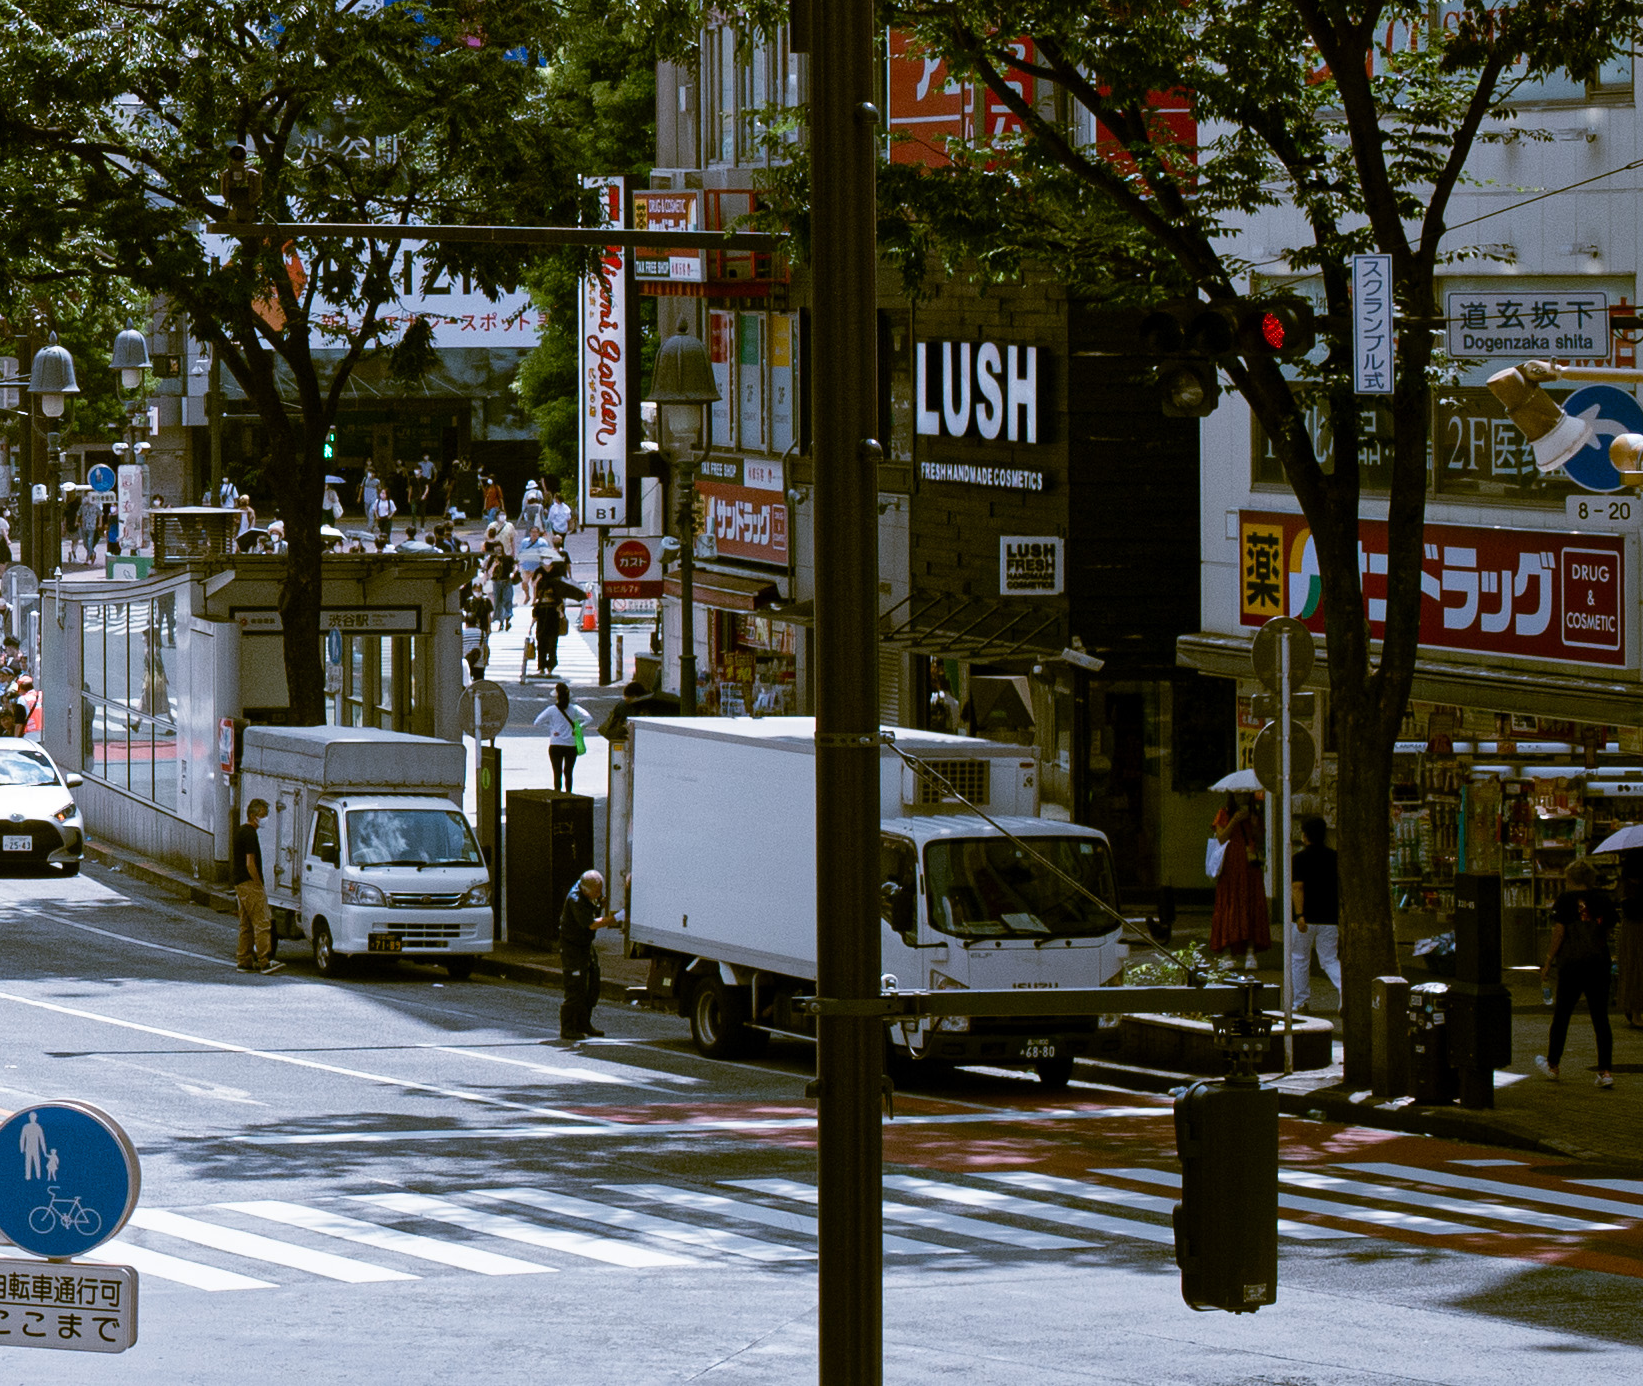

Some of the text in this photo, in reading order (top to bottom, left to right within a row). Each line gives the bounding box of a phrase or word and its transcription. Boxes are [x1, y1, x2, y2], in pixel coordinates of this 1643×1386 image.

[1459, 299, 1597, 331] 道玄坂下
[1362, 260, 1386, 391] スクランブル式
[1463, 333, 1594, 353] Dogenzaka shita
[916, 341, 1037, 444] LUSH
[920, 462, 1043, 491] FRESH HANDMADE COSMETICS
[596, 507, 616, 520] B1
[717, 499, 770, 545] サンドラッグ
[1006, 544, 1056, 557] LUSH
[619, 557, 647, 568] ガスト
[1006, 559, 1056, 571] FRESH
[1246, 531, 1281, 608] 薬
[1006, 572, 1056, 581] HANDMADE
[1571, 563, 1611, 583] DRUG
[1006, 581, 1056, 591] COSMETICS
[1587, 590, 1595, 607] &
[328, 614, 369, 627] 渋谷駅
[1566, 612, 1616, 634] COSMETIC
[1026, 1046, 1055, 1058] 68-80
